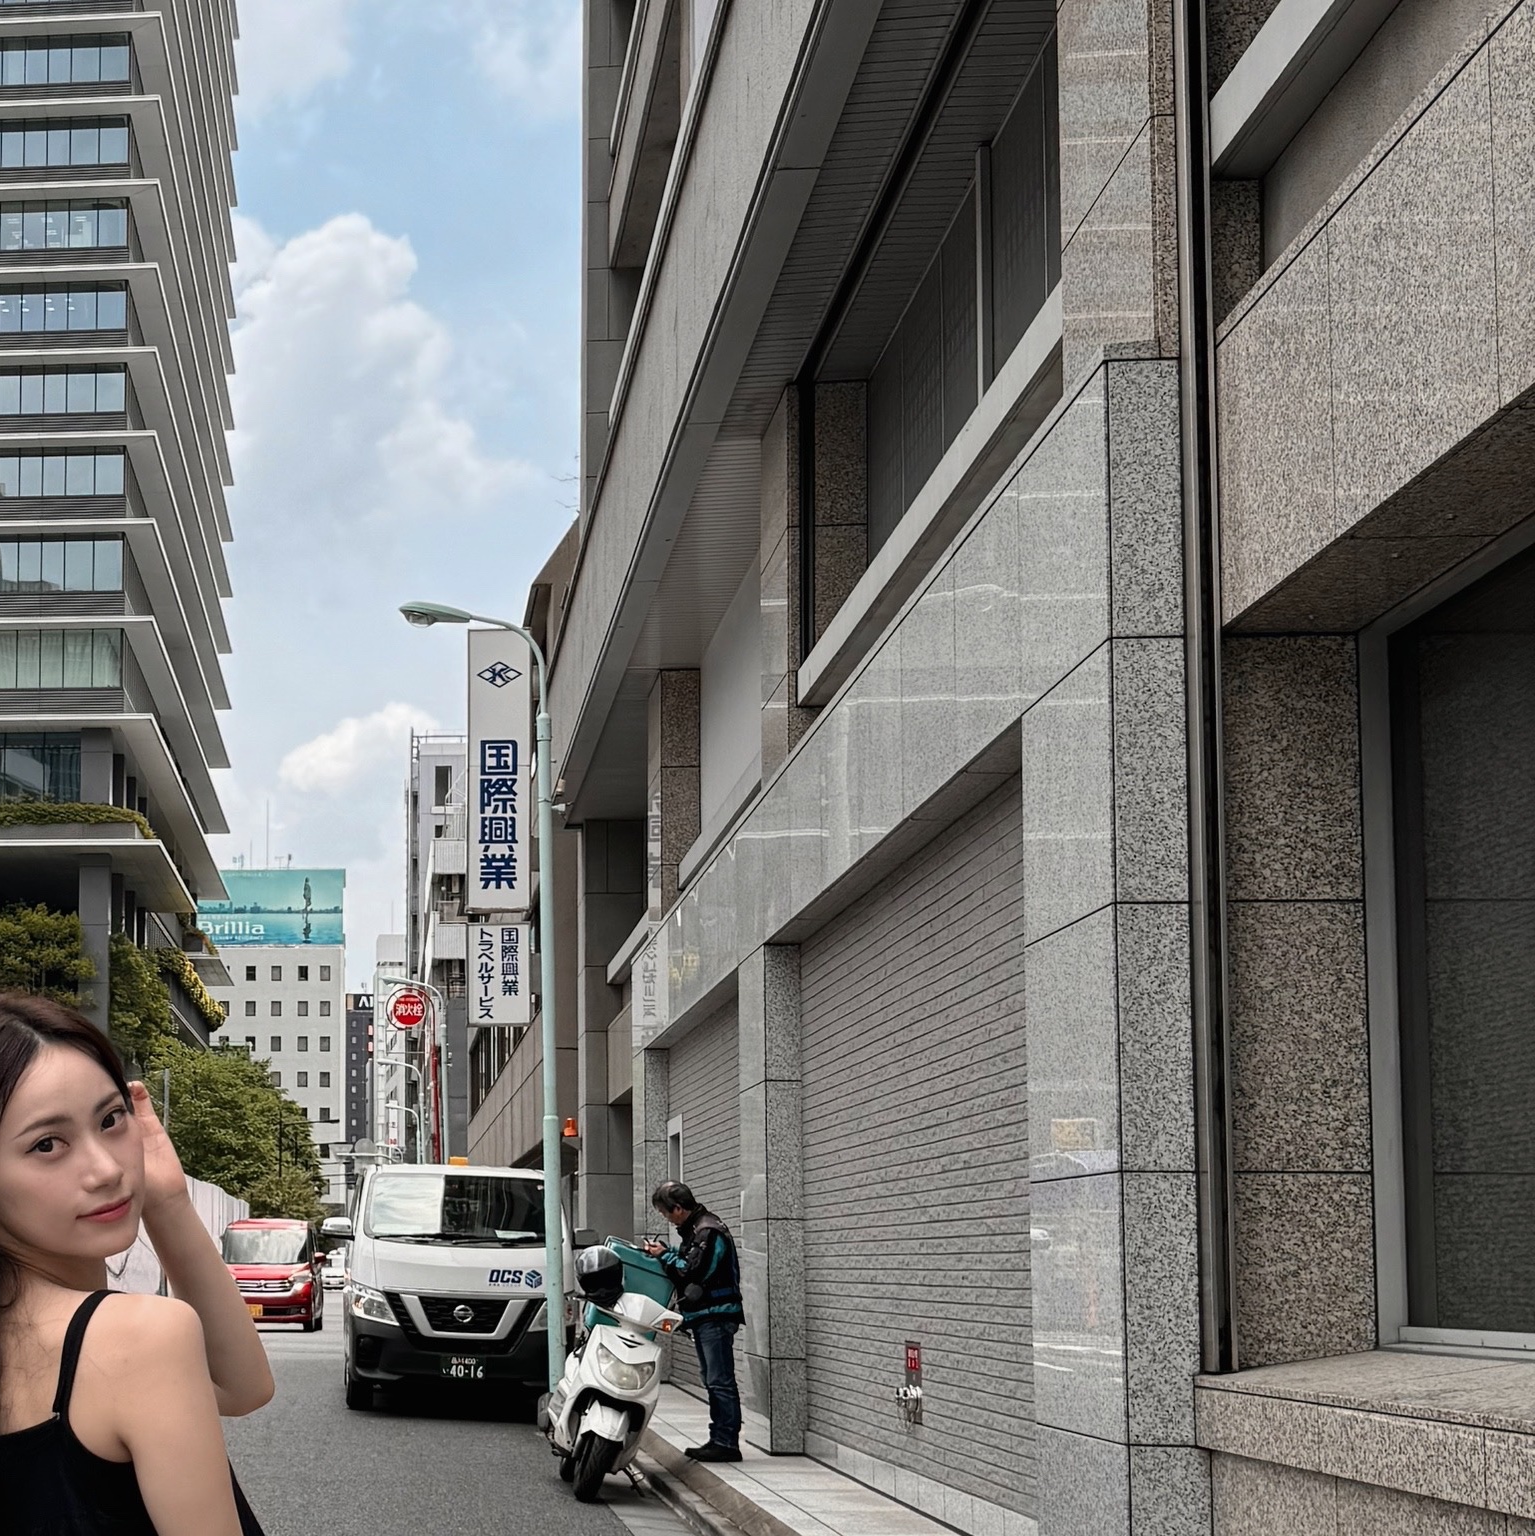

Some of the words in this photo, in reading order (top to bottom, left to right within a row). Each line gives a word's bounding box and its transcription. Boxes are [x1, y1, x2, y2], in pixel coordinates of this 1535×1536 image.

[479, 740, 518, 889] 国際興業
[198, 920, 265, 935] Brillia
[501, 928, 519, 996] 国際興業
[478, 928, 494, 1019] トラベルサービス
[396, 1003, 423, 1016] 消火栓
[489, 1269, 523, 1284] OCS
[450, 1364, 484, 1379] 40-16
